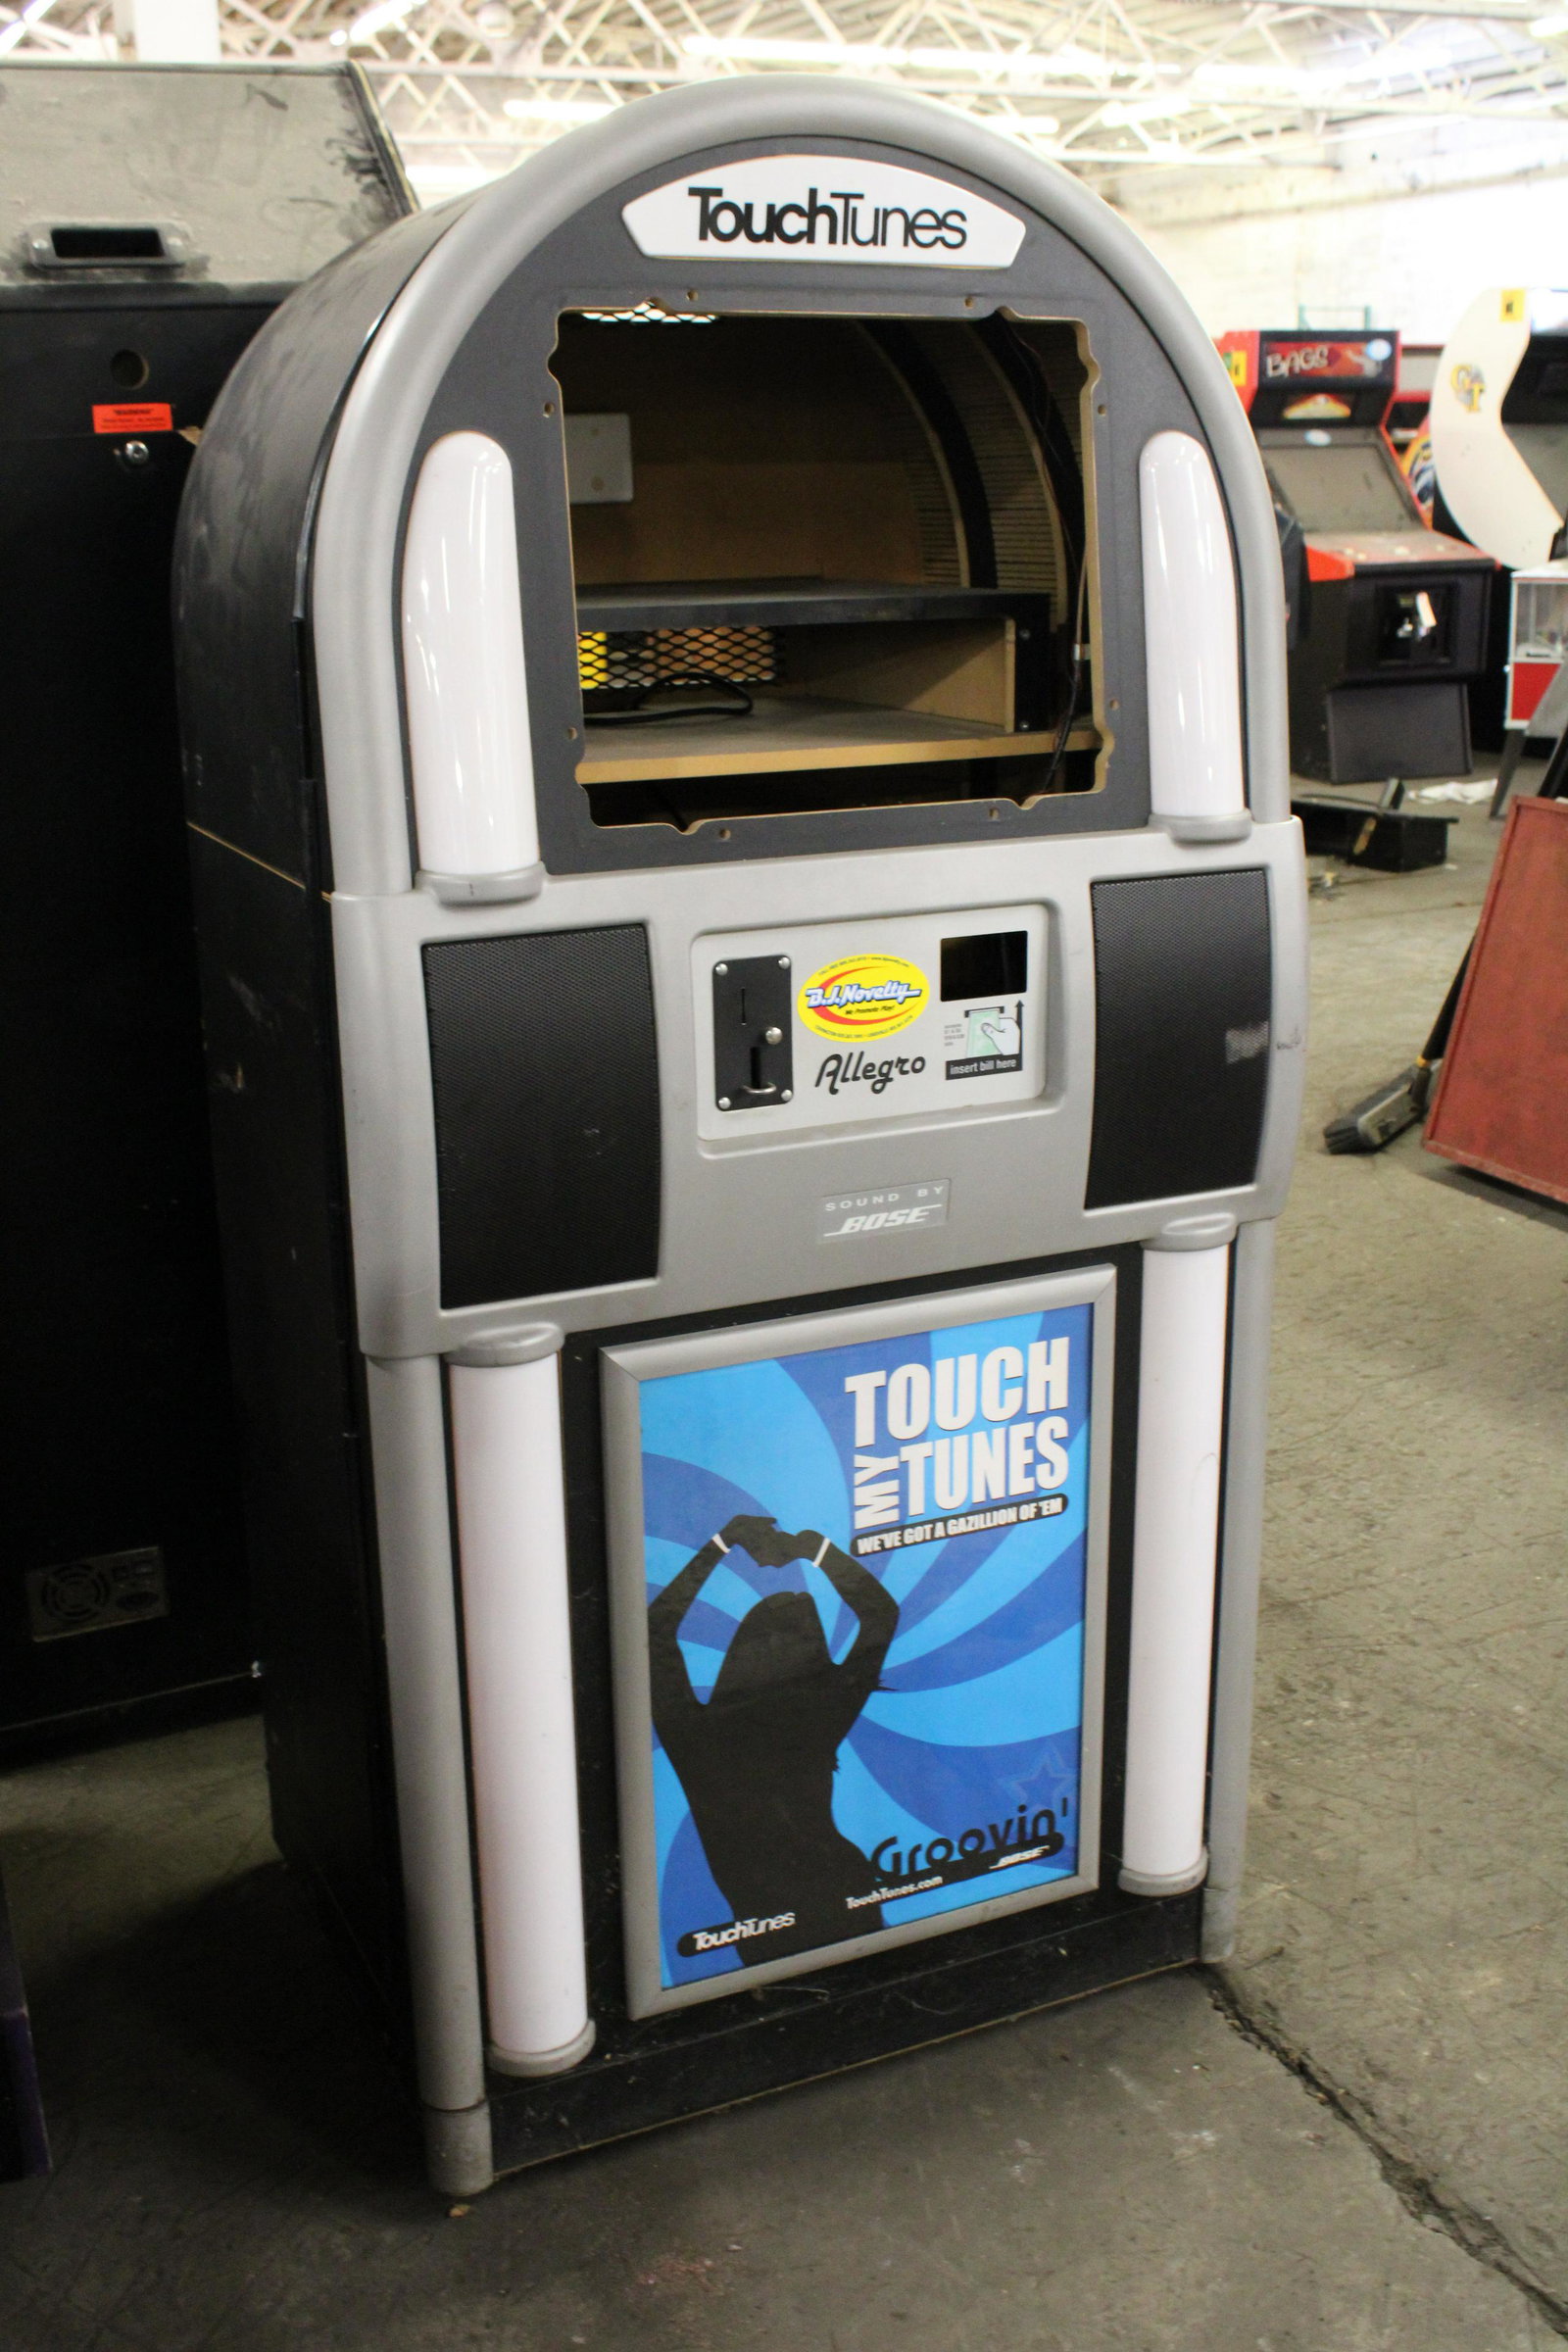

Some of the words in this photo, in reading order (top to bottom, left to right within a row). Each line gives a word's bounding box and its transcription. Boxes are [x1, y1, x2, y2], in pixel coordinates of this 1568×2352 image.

[688, 187, 967, 249] TouchTunes
[839, 980, 922, 1008] Novelty
[814, 1051, 926, 1095] Allegro
[950, 1062, 978, 1075] insert
[979, 1060, 995, 1071] bill
[996, 1059, 1017, 1069] here
[823, 1204, 943, 1237] BOSE
[825, 1193, 900, 1211] SOUND
[917, 1186, 945, 1198] BY
[845, 1337, 1069, 1448] TOUCH
[900, 1416, 1069, 1517] TUNES
[854, 1454, 900, 1530] MY
[857, 1532, 903, 1554] WE'VE
[903, 1524, 933, 1544] GOT
[934, 1522, 946, 1538] A
[947, 1507, 1017, 1536] GAZILLION
[1018, 1503, 1038, 1521] OF
[870, 1797, 1068, 1882] Groovin'
[847, 1876, 943, 1909] TouchTunes.com
[692, 1912, 796, 1951] TouchTunes
